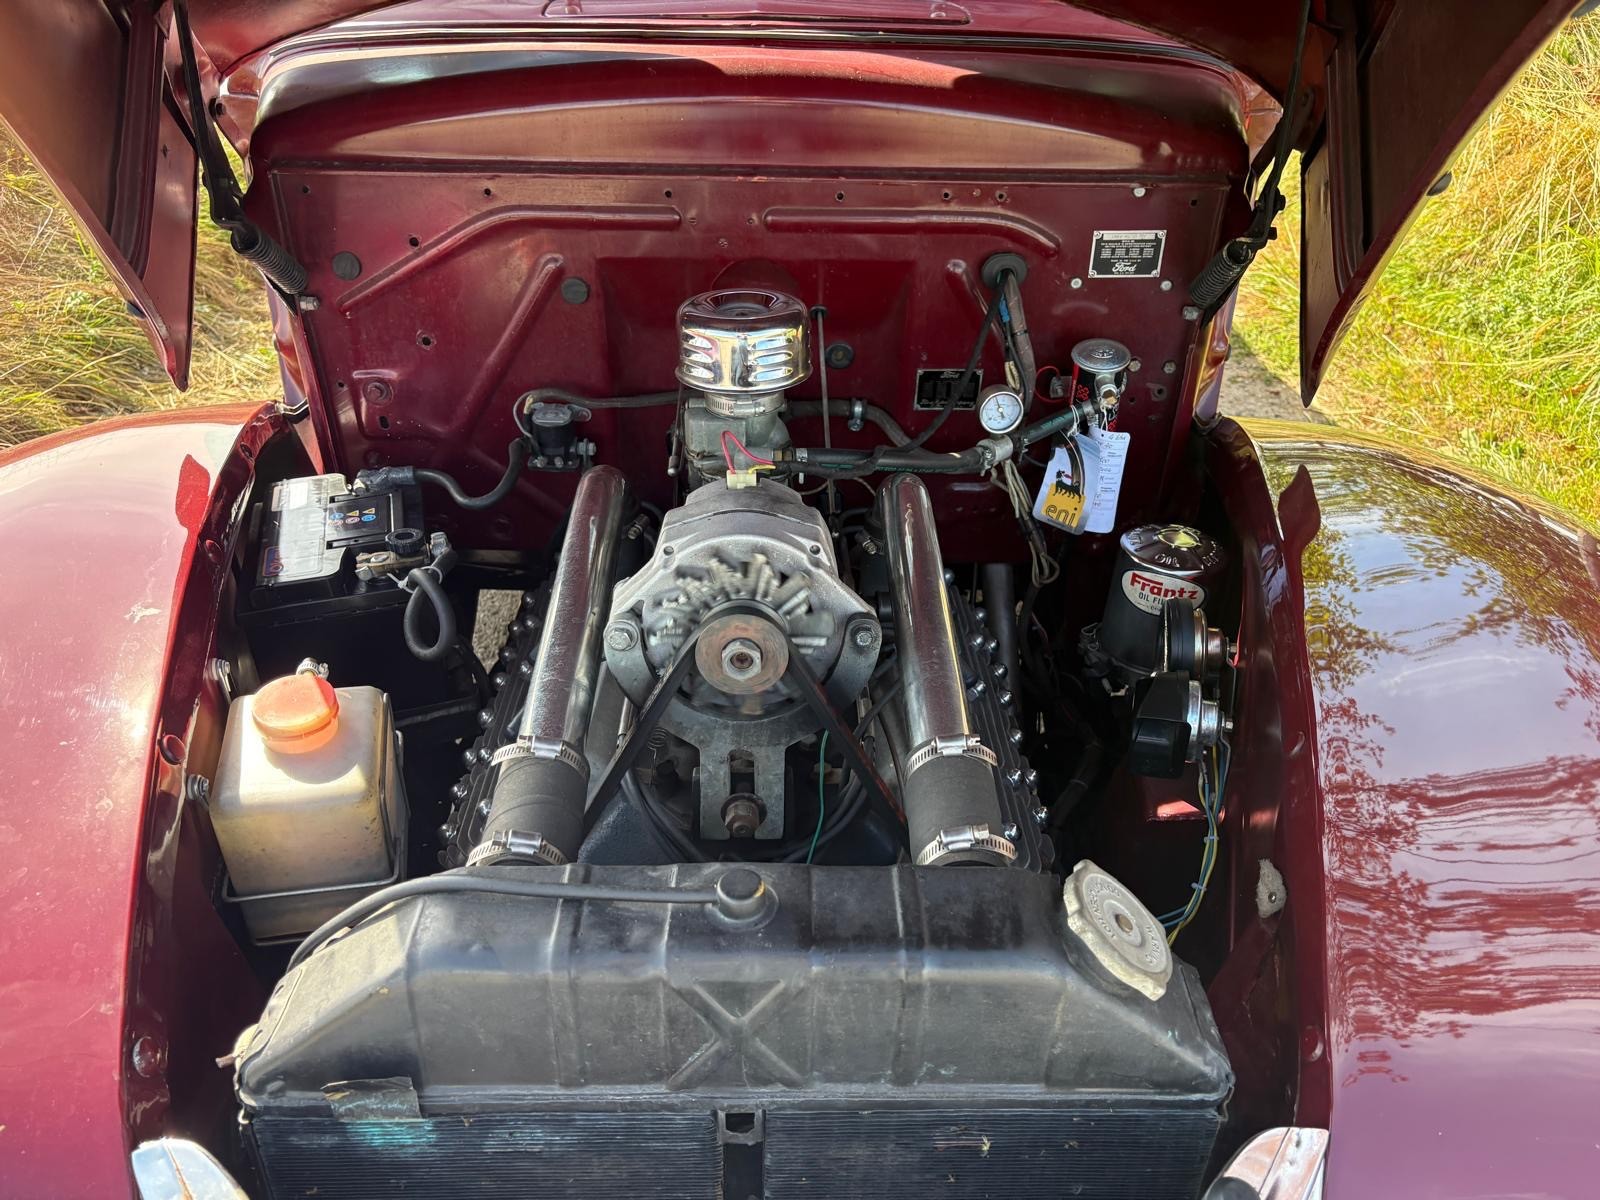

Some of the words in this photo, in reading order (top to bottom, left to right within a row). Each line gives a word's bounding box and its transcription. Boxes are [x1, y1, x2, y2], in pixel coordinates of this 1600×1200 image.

[1112, 261, 1137, 272] Ford
[1045, 504, 1077, 526] eni
[1129, 571, 1199, 600] Frantz
[1138, 591, 1150, 602] OIL
